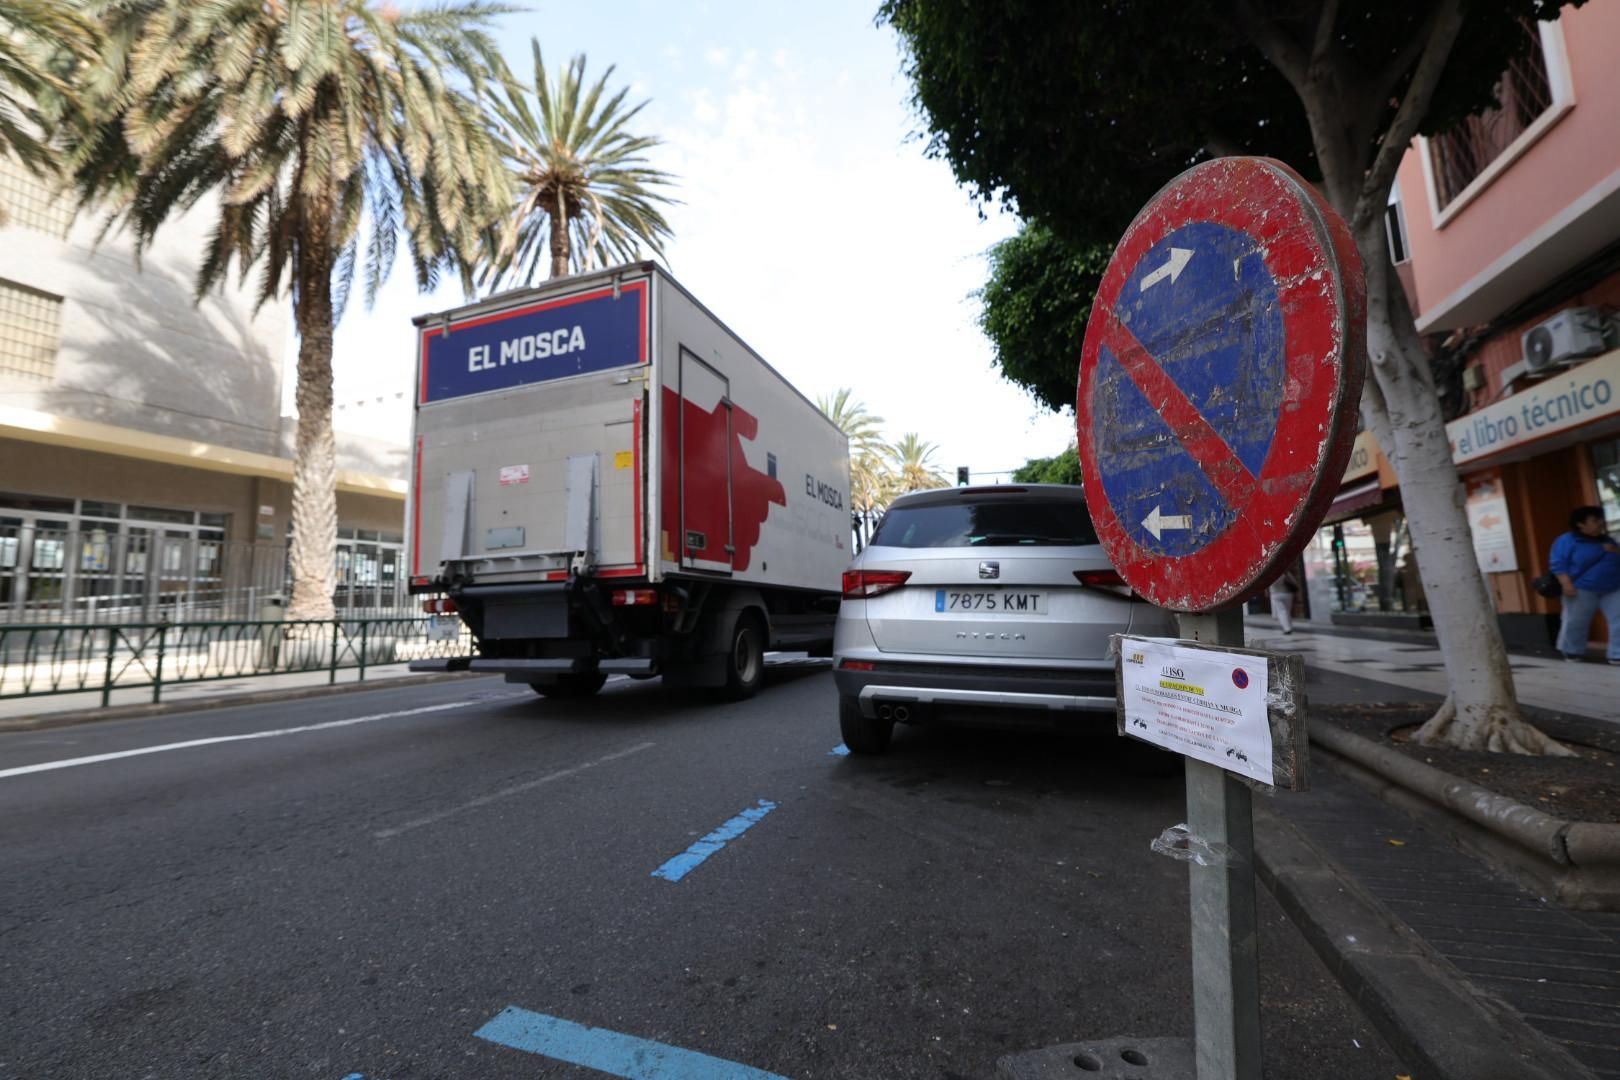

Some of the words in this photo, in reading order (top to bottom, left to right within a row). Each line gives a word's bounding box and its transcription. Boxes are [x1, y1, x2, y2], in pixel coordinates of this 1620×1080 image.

[468, 344, 497, 372] EL
[499, 325, 586, 366] MOSCA
[1459, 428, 1473, 455] el
[1473, 416, 1518, 449] libro
[1521, 379, 1612, 431] técnico
[805, 472, 817, 499] EL
[817, 479, 844, 512] MOSCA
[950, 593, 997, 609] 7875
[1003, 593, 1041, 610] KMT
